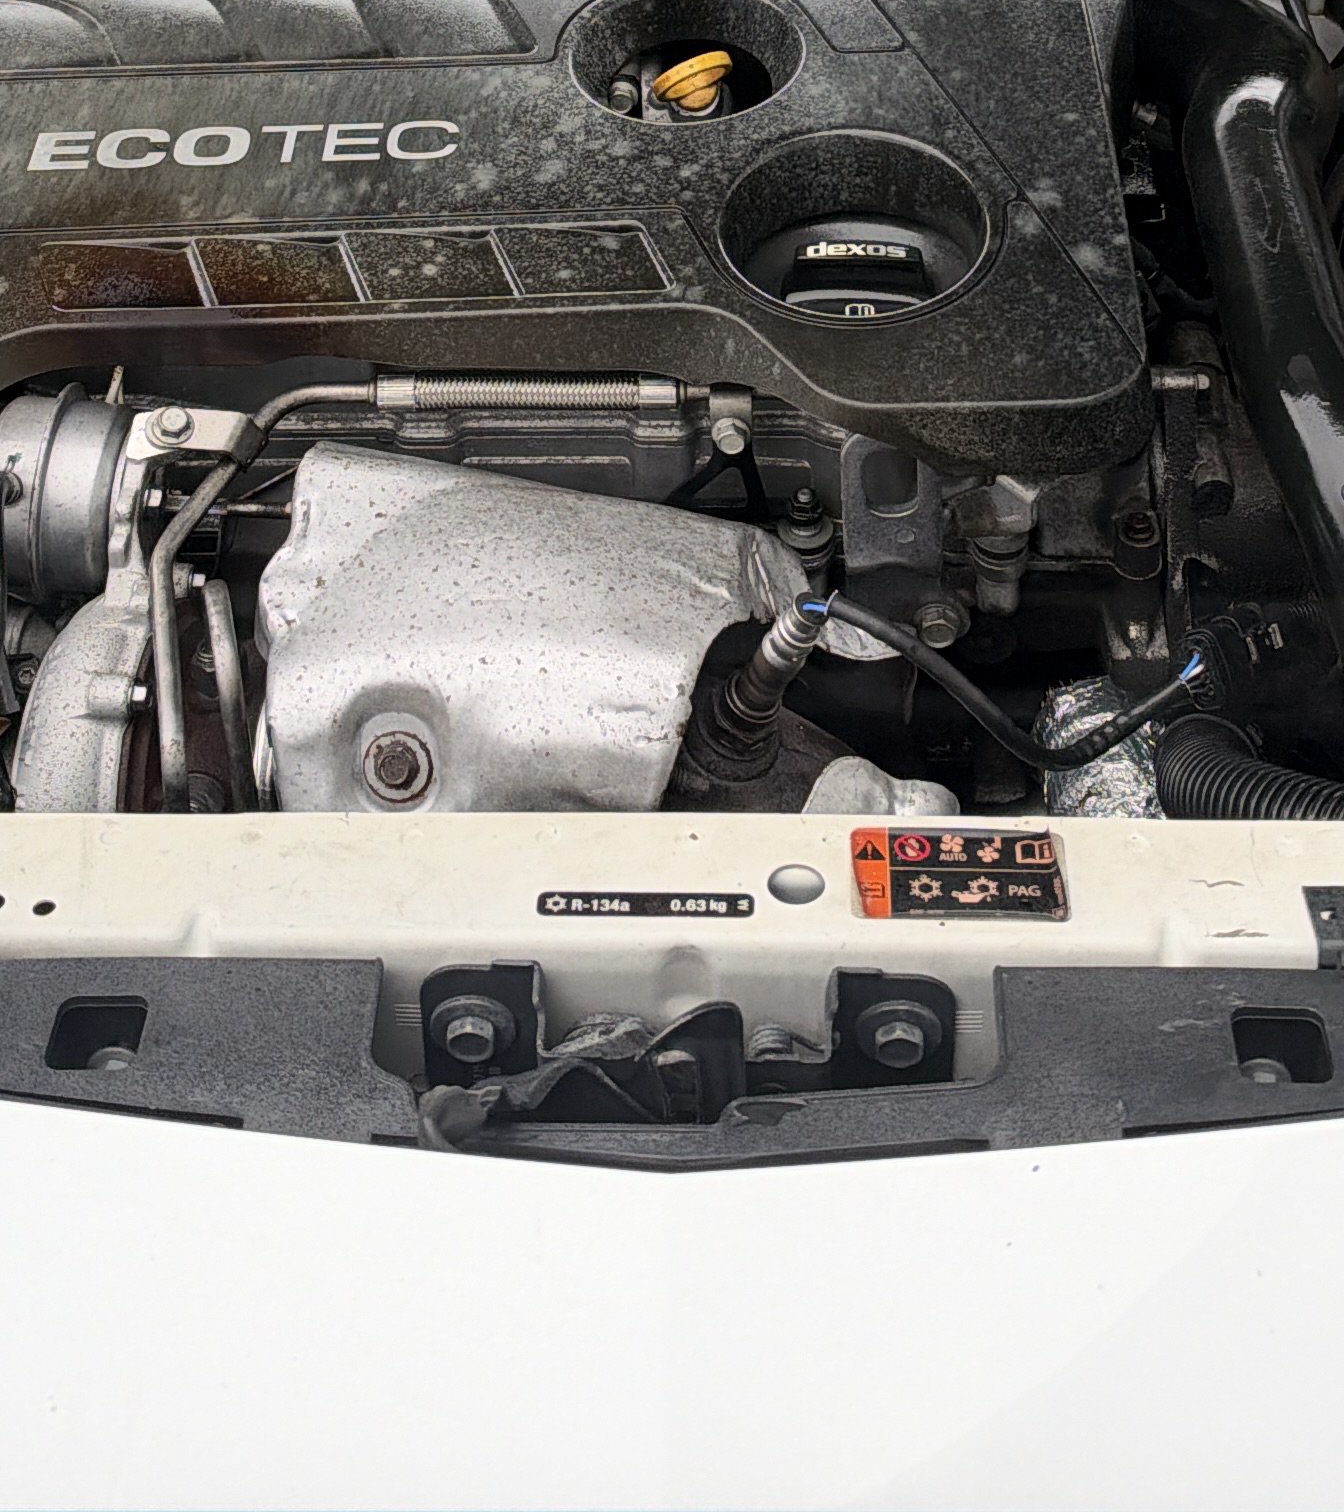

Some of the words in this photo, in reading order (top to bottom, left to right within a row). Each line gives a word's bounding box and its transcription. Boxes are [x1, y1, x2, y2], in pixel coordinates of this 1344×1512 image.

[27, 119, 461, 173] ECOTEC
[806, 241, 907, 259] dexos
[938, 853, 967, 862] AUTO
[1008, 884, 1042, 897] PAG
[571, 898, 630, 912] R-134a
[670, 899, 706, 912] 0.63
[710, 899, 727, 914] kg
